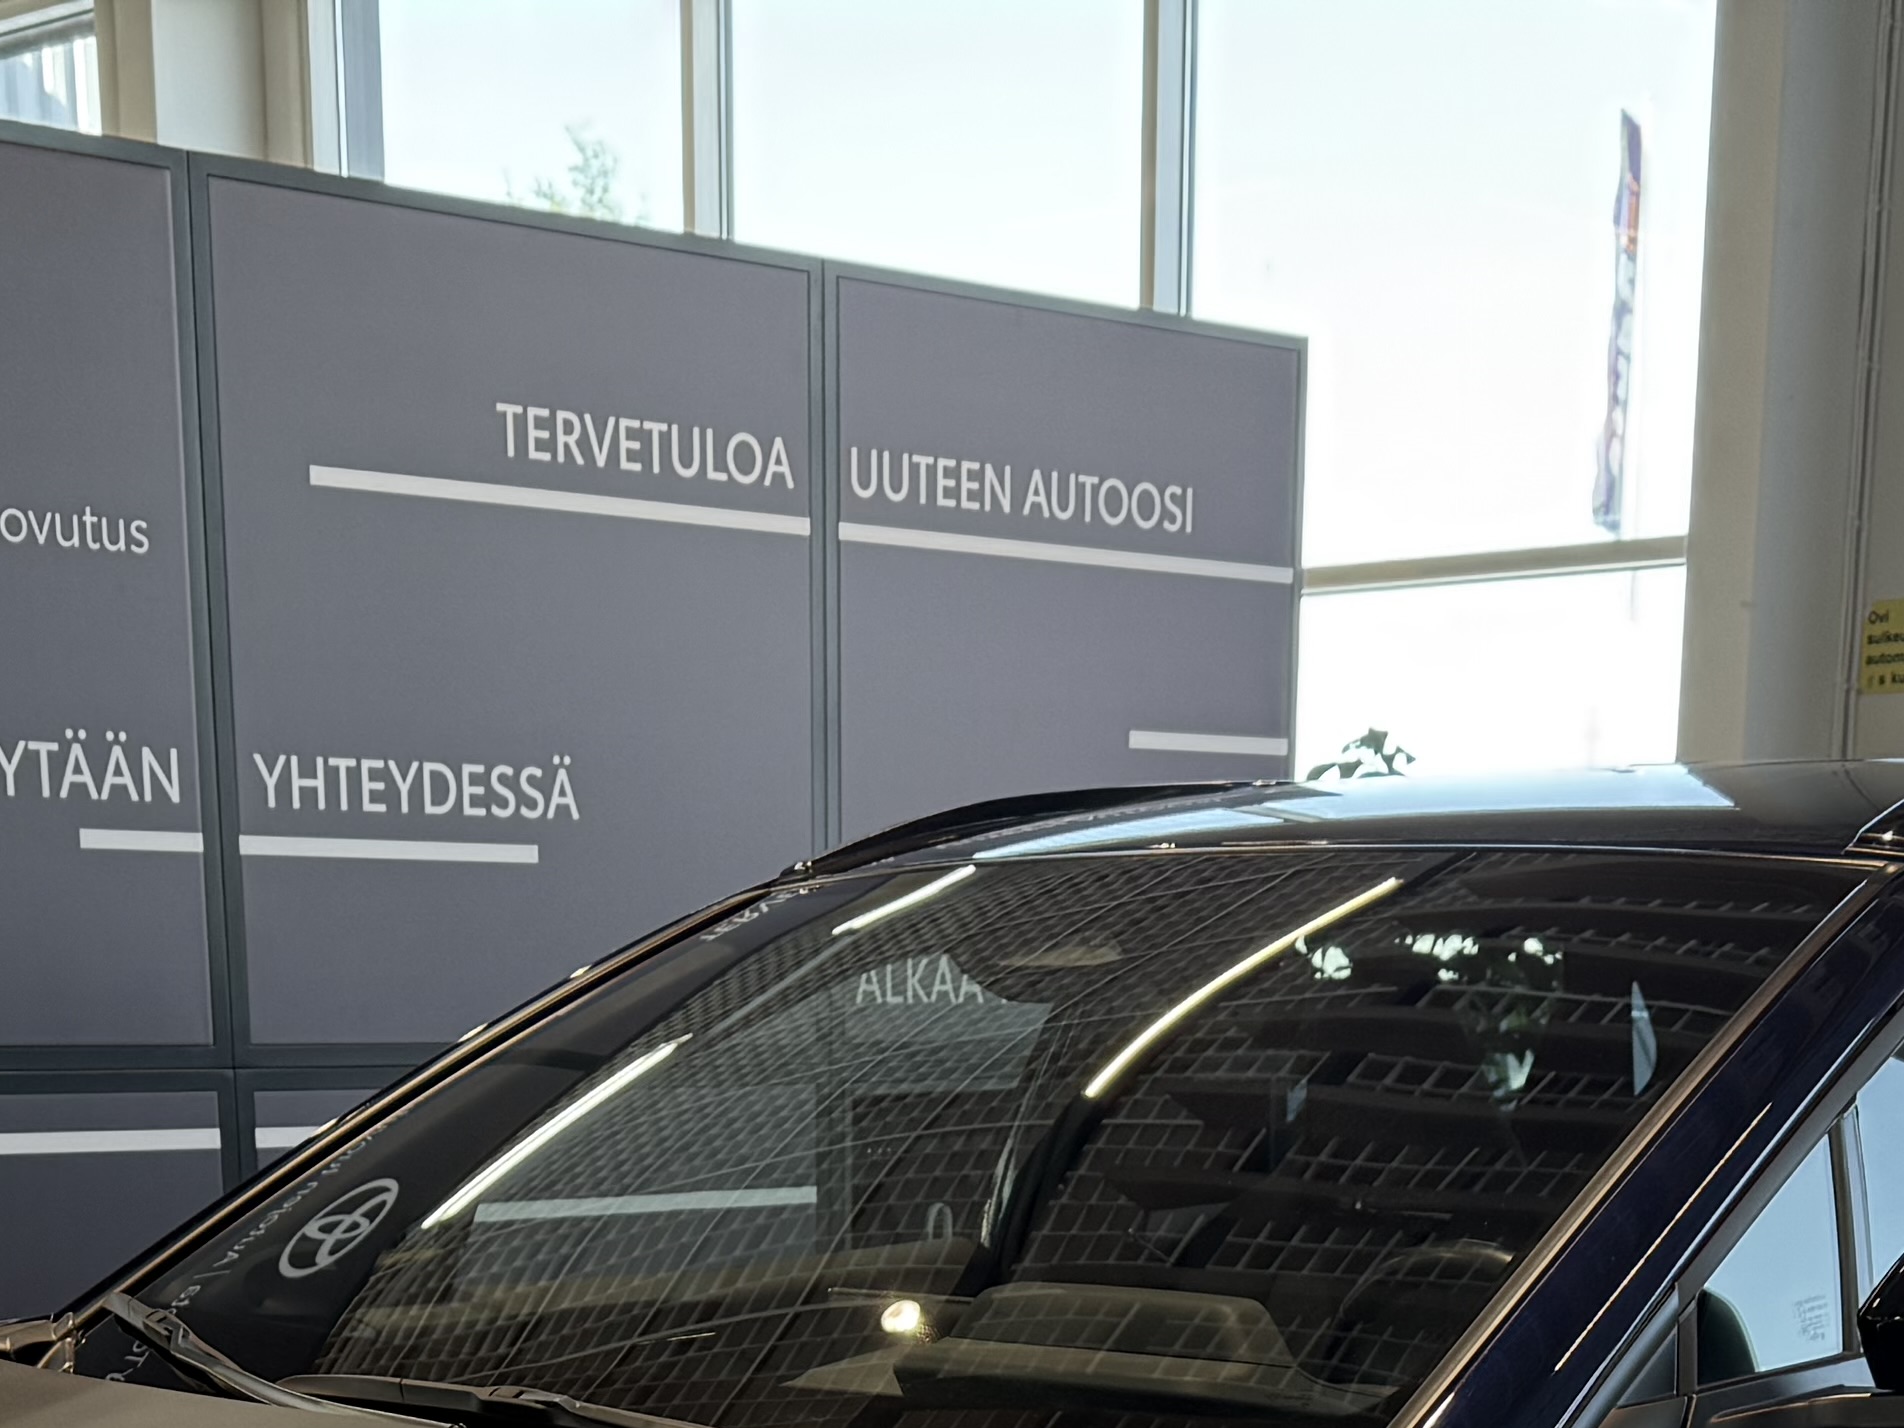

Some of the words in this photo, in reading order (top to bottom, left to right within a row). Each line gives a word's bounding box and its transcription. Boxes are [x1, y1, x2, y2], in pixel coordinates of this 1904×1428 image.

[496, 402, 794, 490] TERVETULOA
[849, 446, 1012, 514] UUTEEN
[1022, 468, 1194, 534] AUTOOSI
[1867, 610, 1890, 626] Ovi
[252, 752, 581, 821] YHTEYDESSÄ
